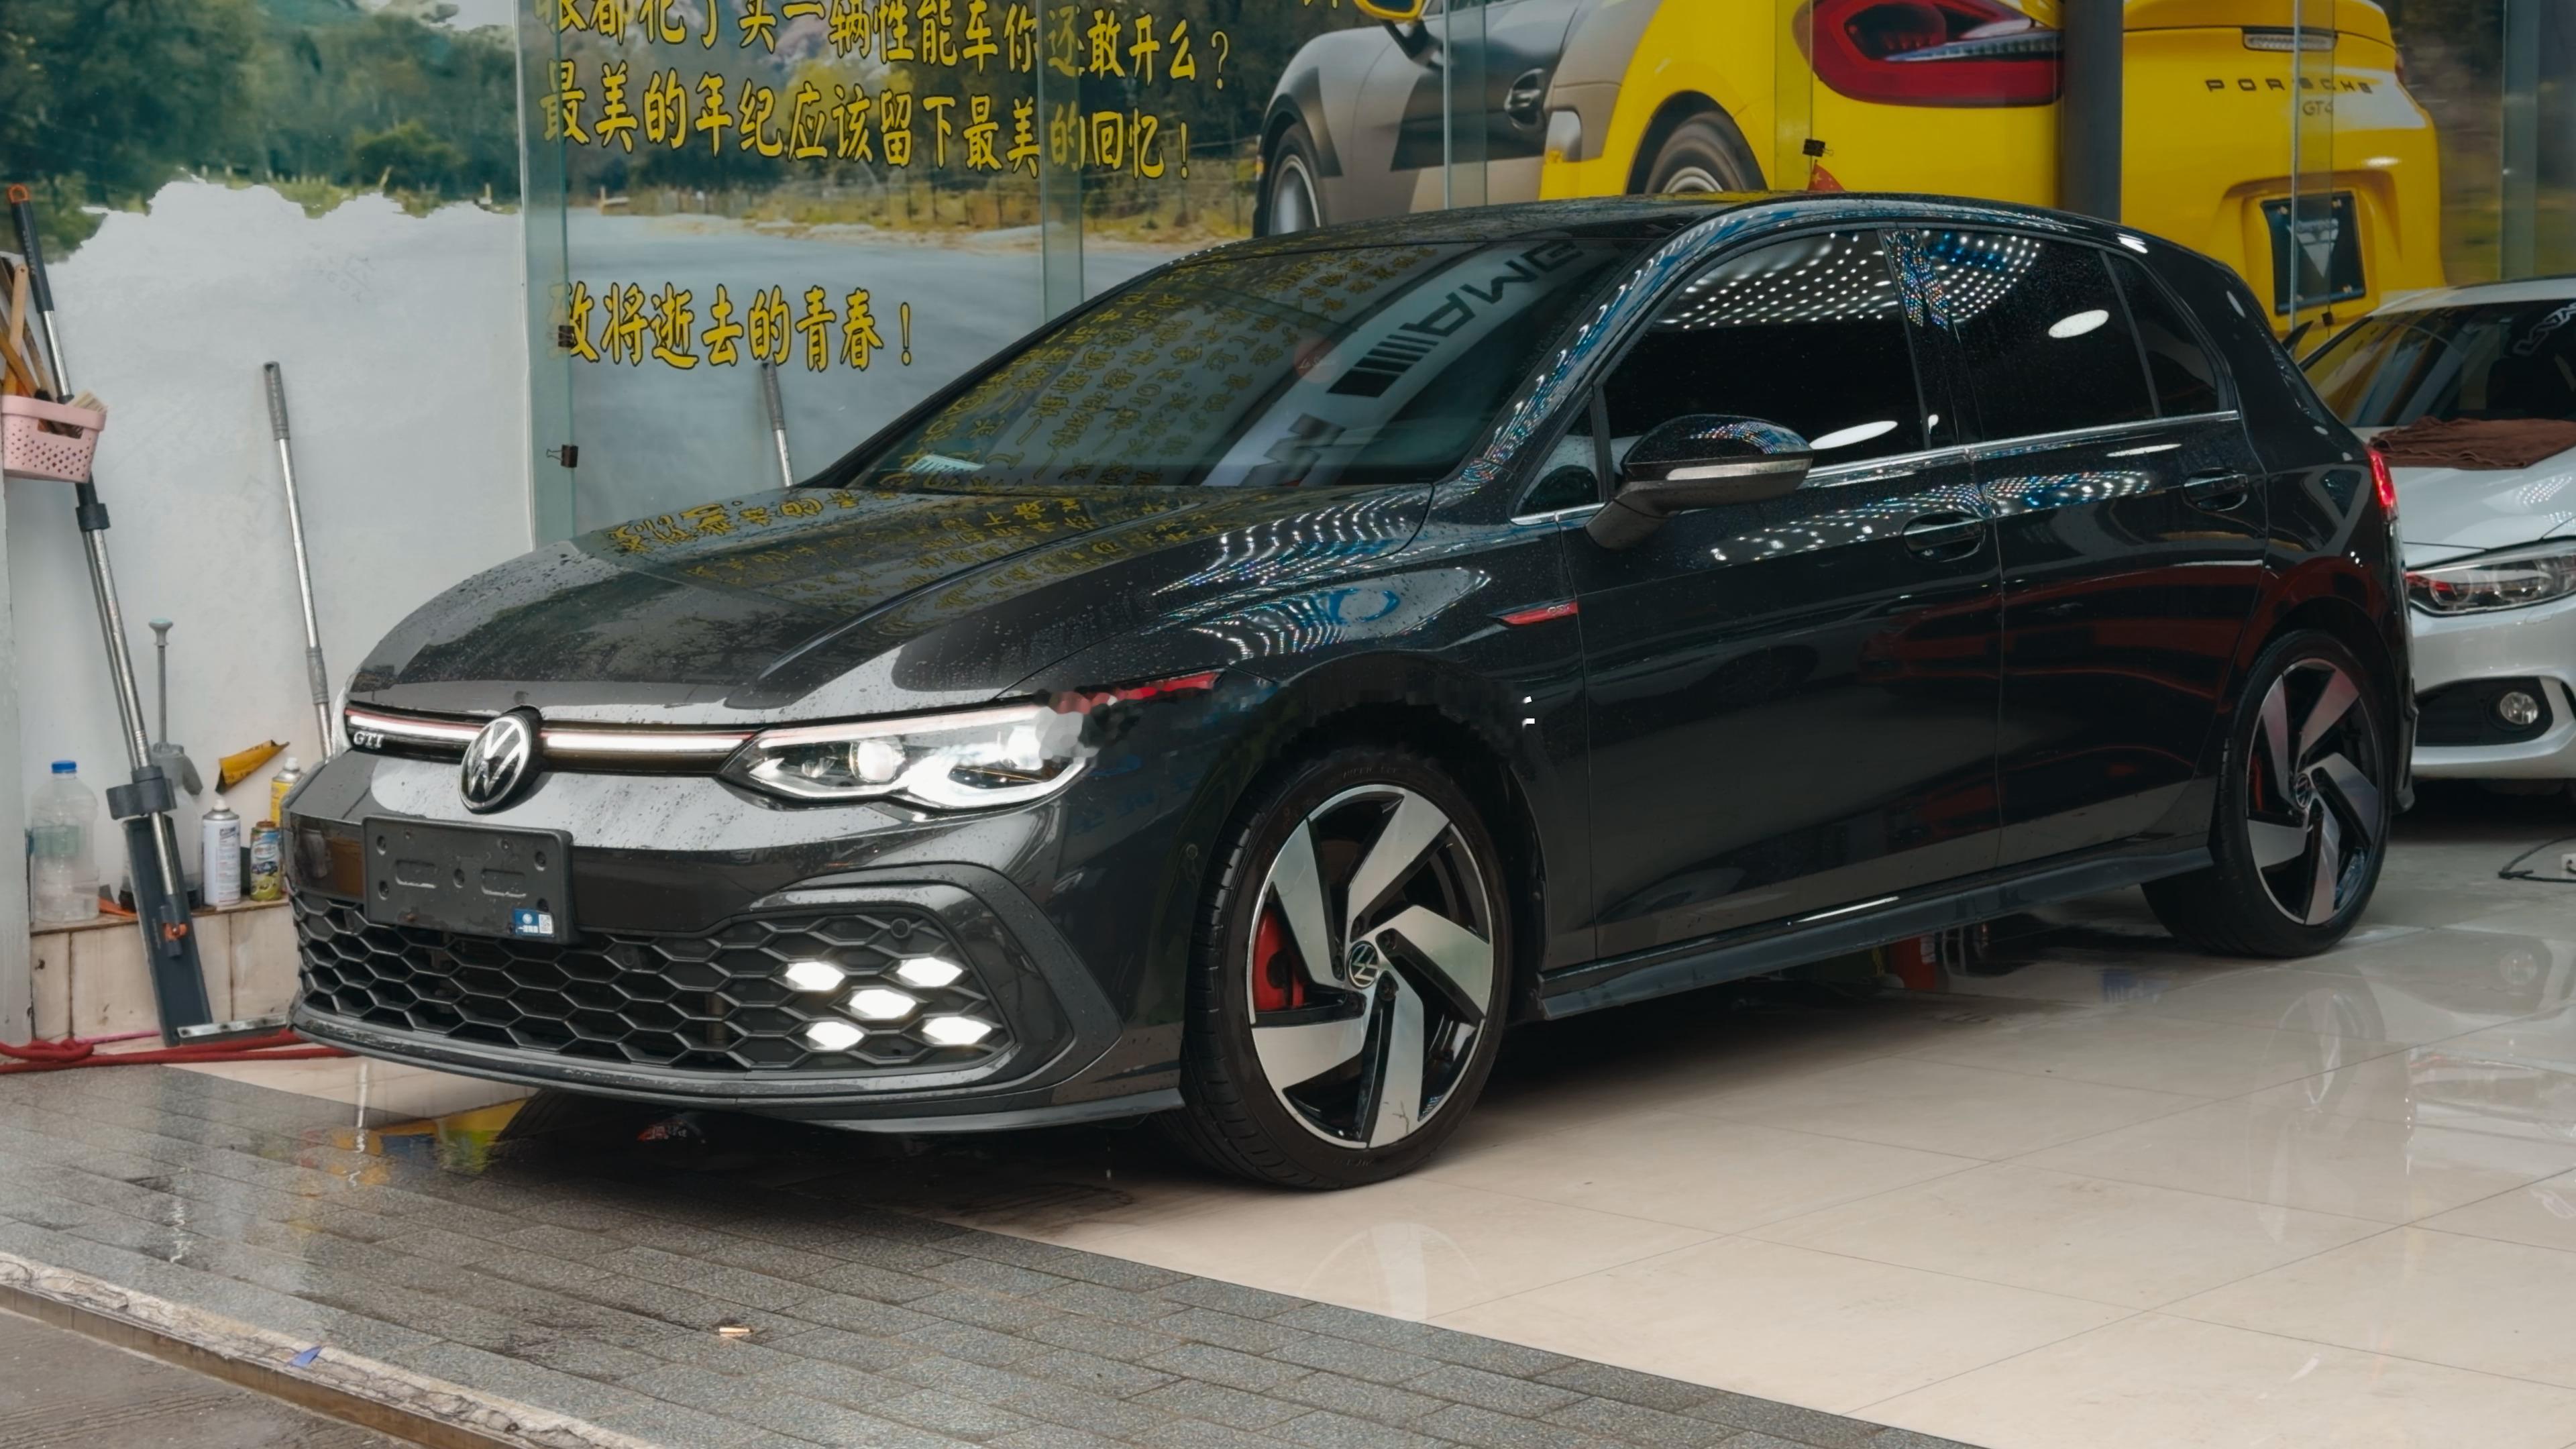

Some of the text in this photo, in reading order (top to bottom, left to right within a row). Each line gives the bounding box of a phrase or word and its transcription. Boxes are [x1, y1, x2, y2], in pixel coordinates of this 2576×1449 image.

[2205, 76, 2373, 95] PORSCHE
[539, 58, 1189, 179] 最美的年纪应该留下最美的回忆！
[353, 730, 385, 749] GTI
